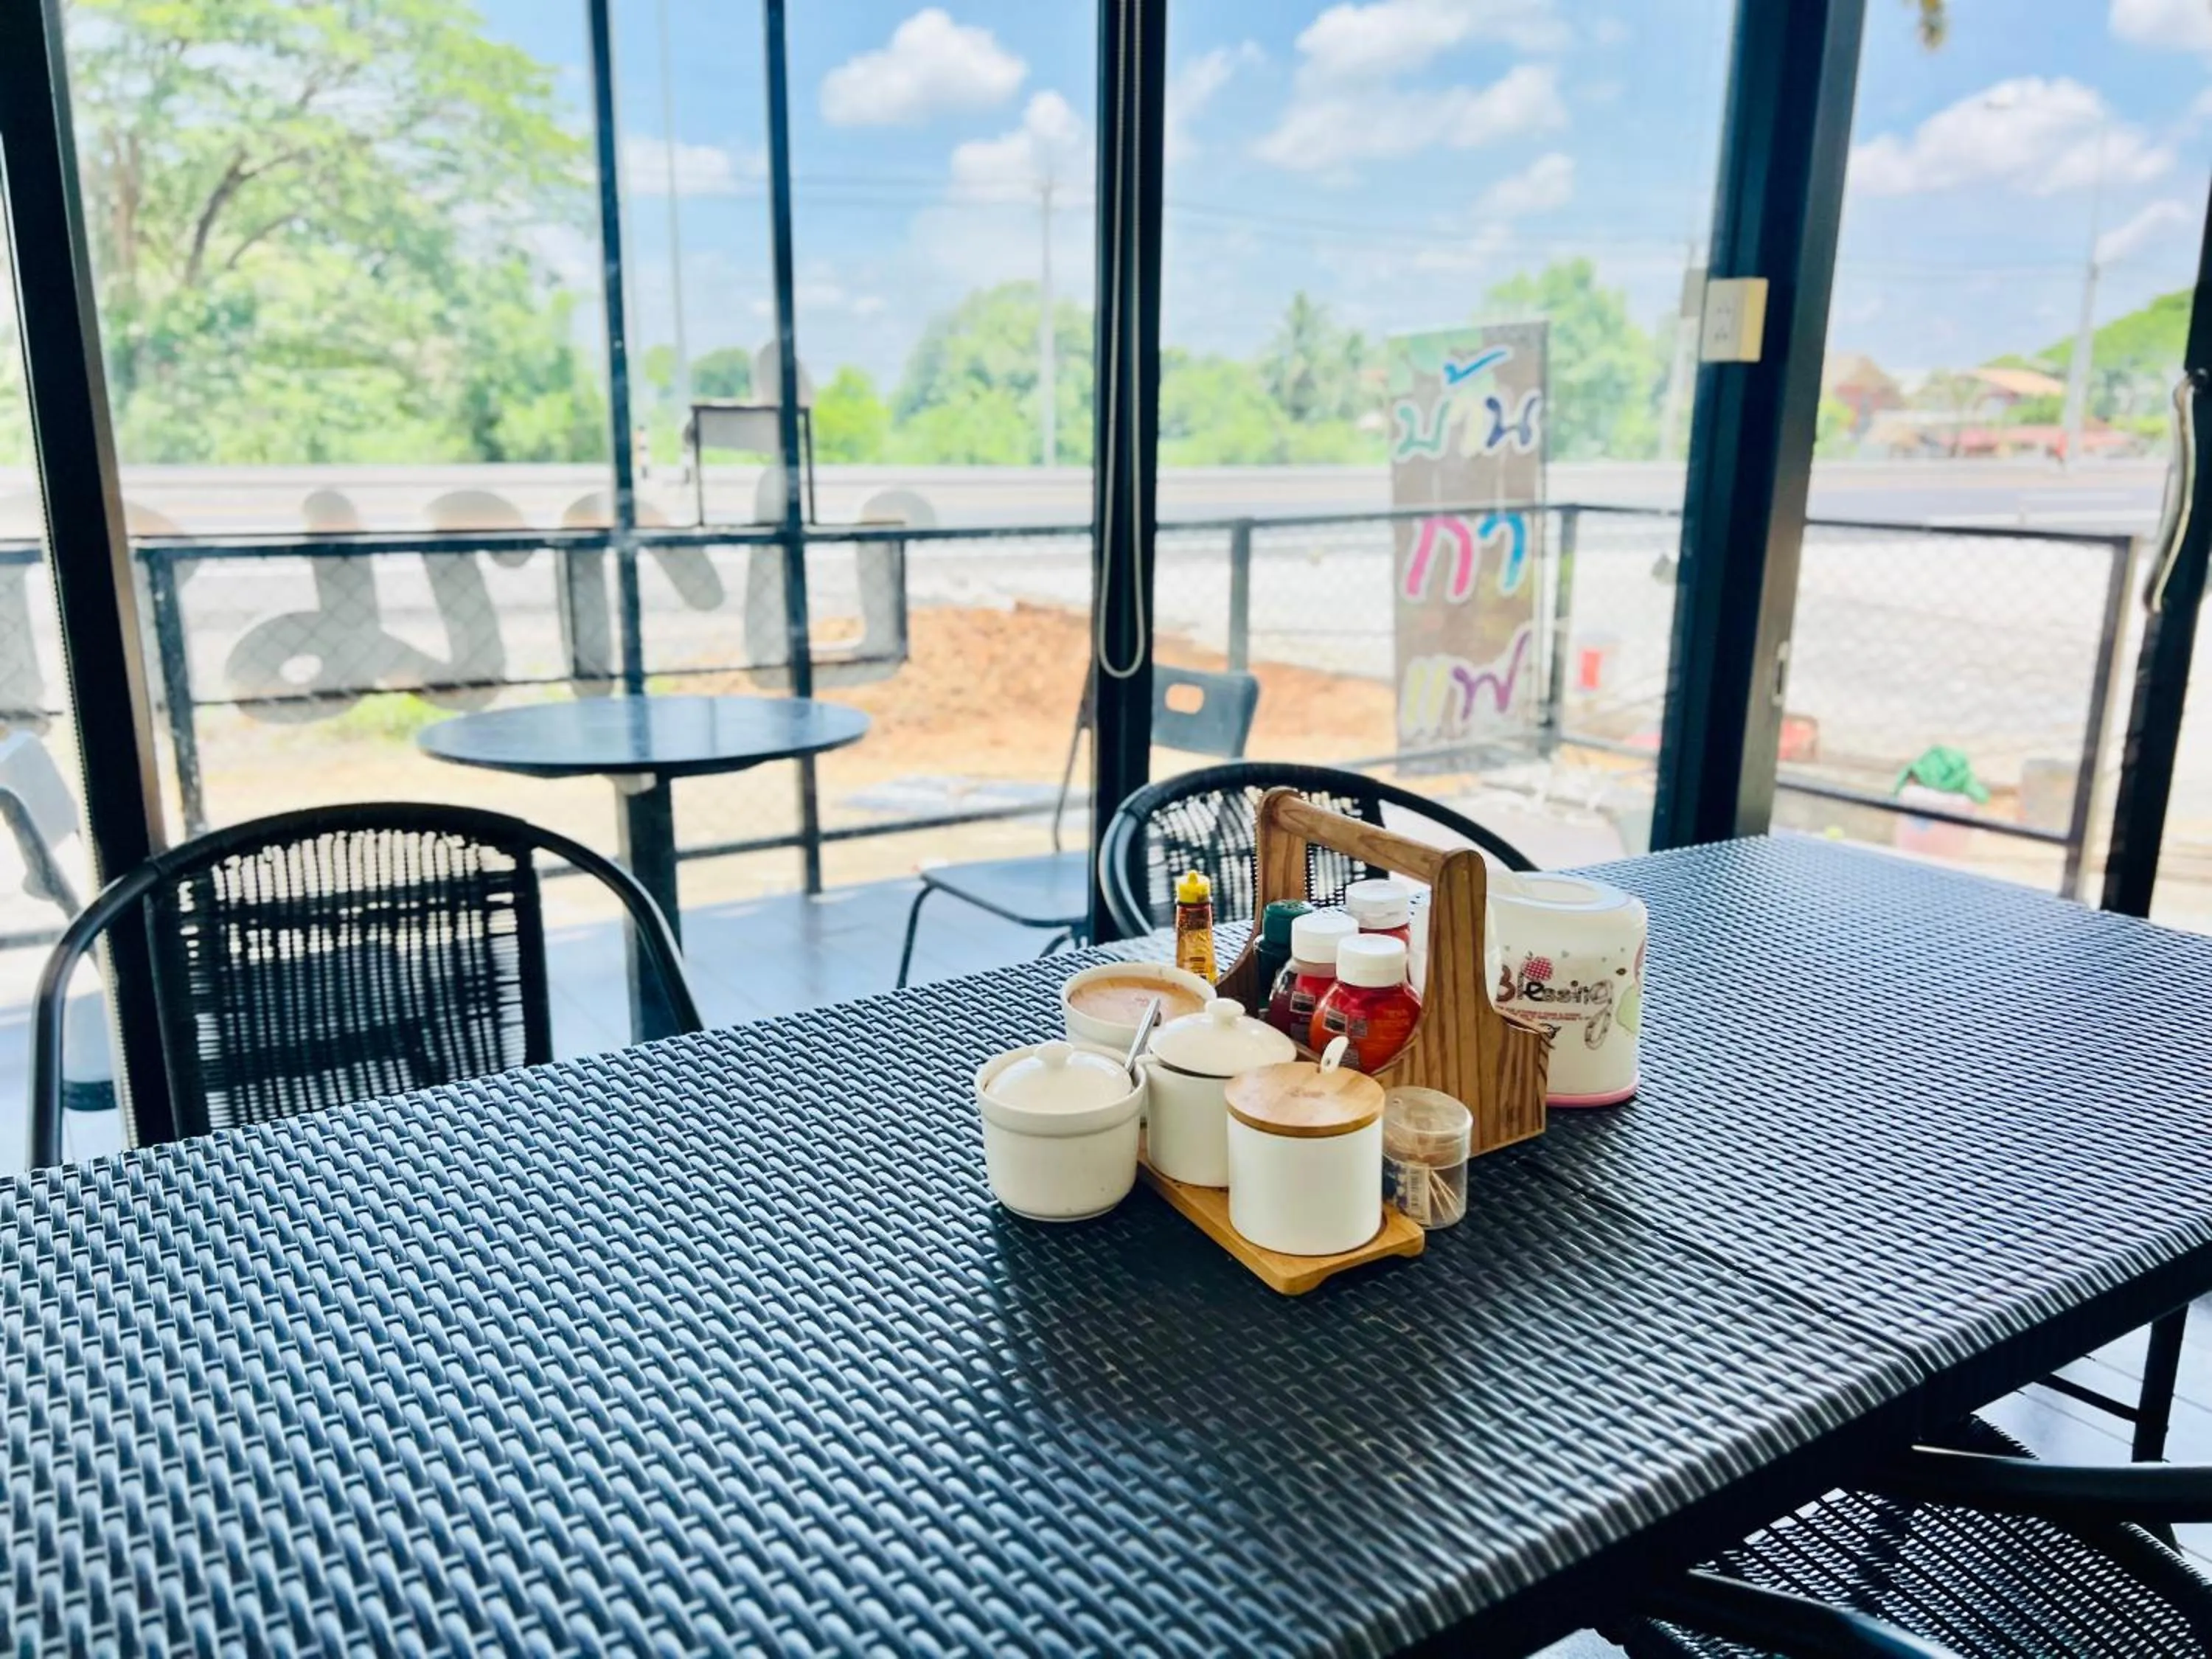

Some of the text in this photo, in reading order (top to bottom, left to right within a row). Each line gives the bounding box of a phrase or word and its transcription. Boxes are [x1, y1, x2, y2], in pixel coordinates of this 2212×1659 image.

[1393, 348, 1541, 459] บ้าน
[1402, 510, 1531, 601] กา
[1401, 629, 1534, 728] แฟ
